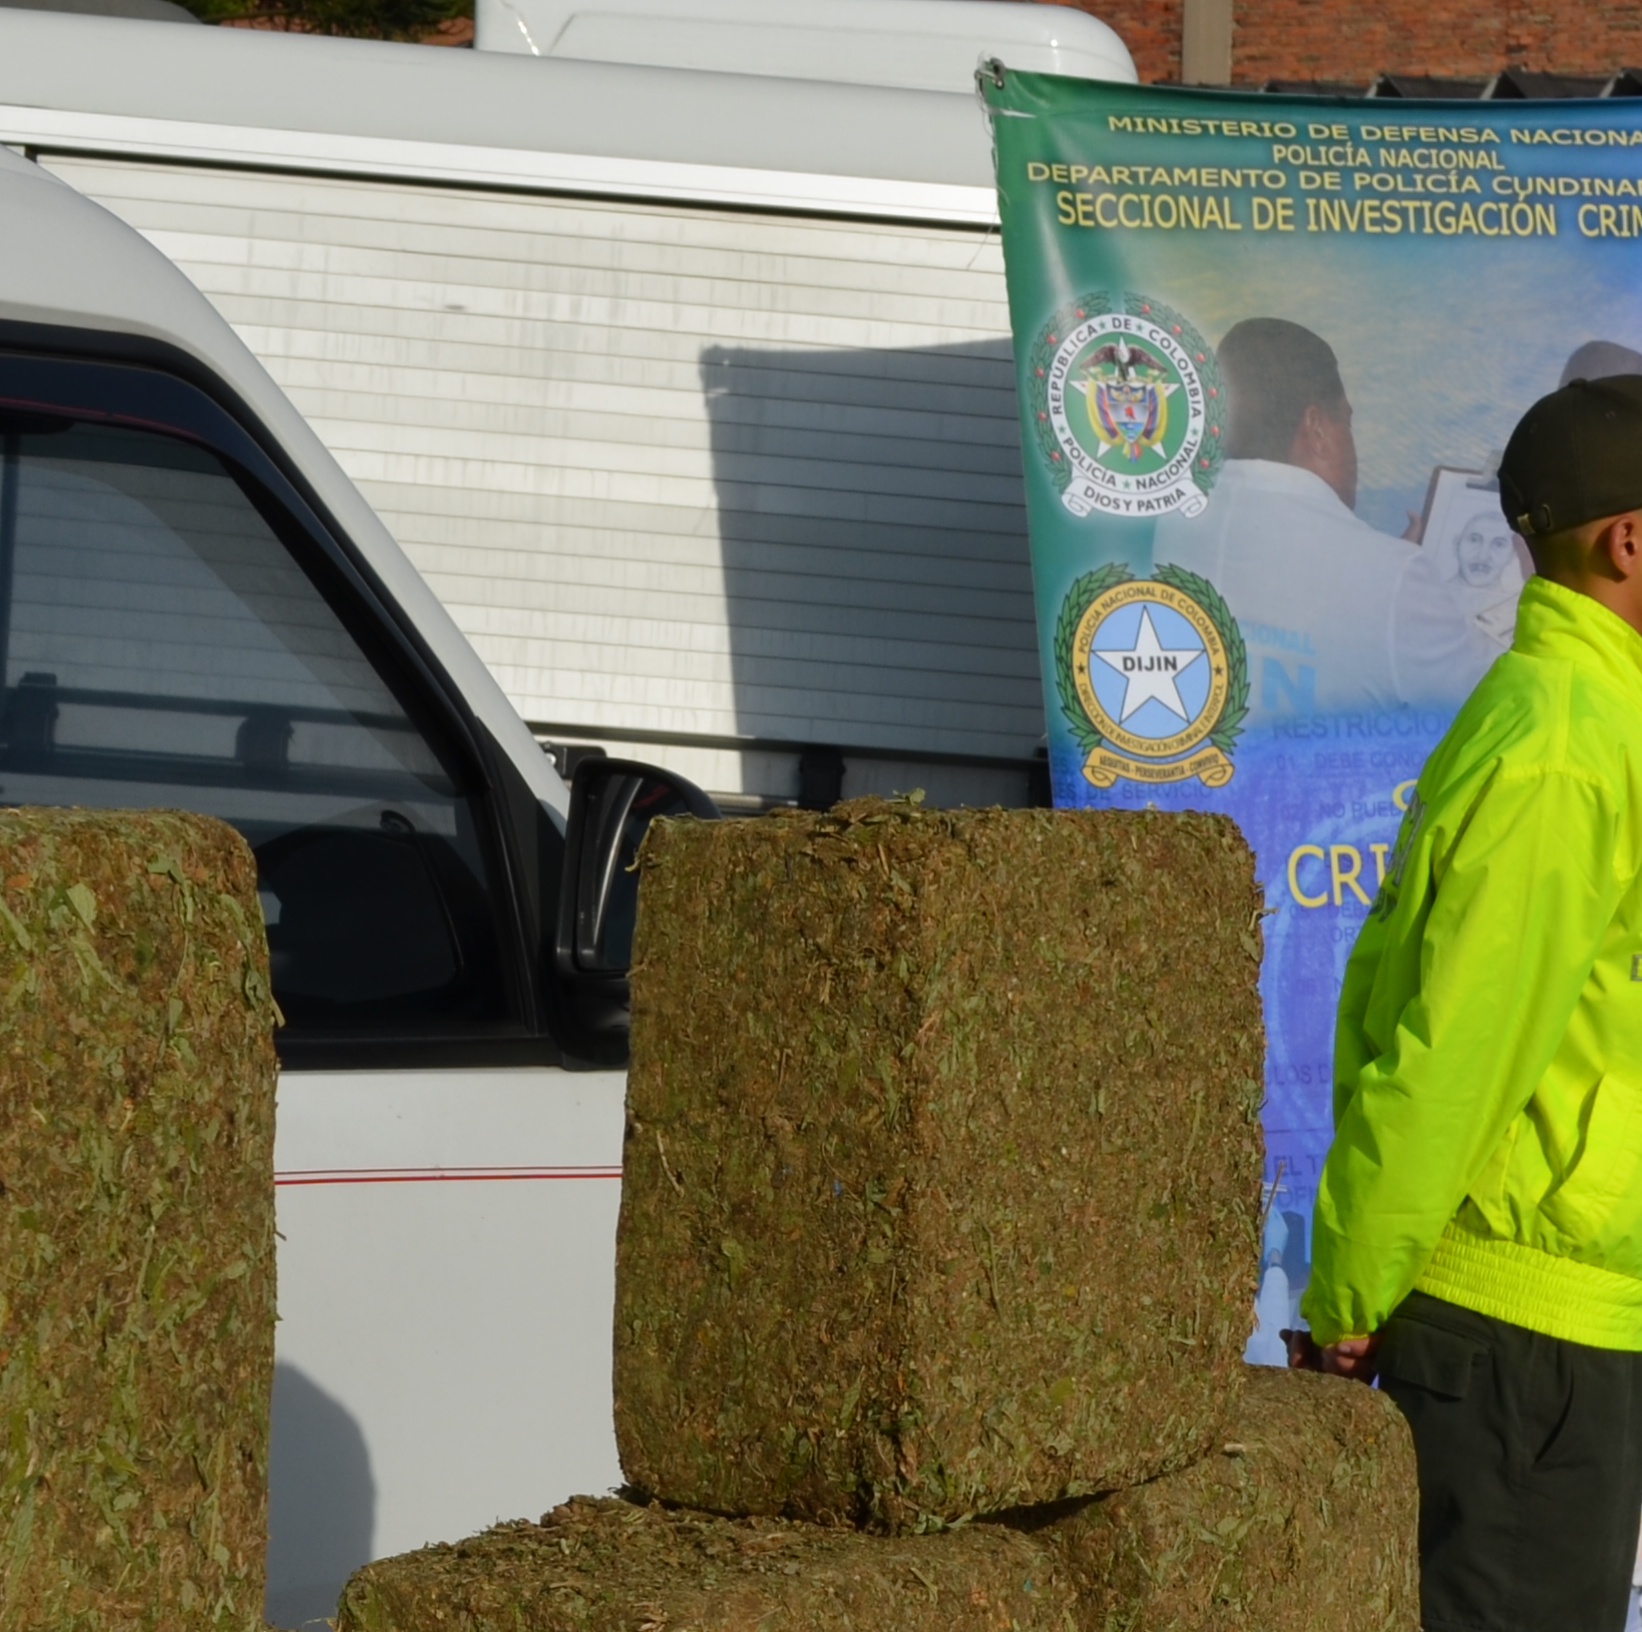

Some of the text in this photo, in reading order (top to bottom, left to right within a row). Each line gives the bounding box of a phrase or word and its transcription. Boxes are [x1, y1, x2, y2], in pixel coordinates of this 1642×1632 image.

[1108, 115, 1297, 138] MINISTERIO
[1308, 122, 1349, 140] DE
[1360, 125, 1500, 143] DEFENSA
[1272, 141, 1505, 170] POLICÍA NACIONAL
[1027, 161, 1287, 189] DEPARTAMENTO
[1299, 171, 1342, 190] DE
[1354, 169, 1482, 194] POLICÍA
[1057, 190, 1242, 230] SECCIONAL
[1252, 195, 1295, 231] DE
[1307, 190, 1557, 237] INVESTIGACIÓN
[1111, 316, 1132, 331] DE
[1148, 327, 1203, 419] COLOMBIA
[1135, 438, 1199, 491] NACIONAL
[1082, 484, 1187, 512] DIOS Y PATRIA
[1101, 586, 1157, 611] NACIONAL
[1160, 588, 1177, 603] DE
[1177, 598, 1221, 656] COLOMBIA
[1122, 655, 1178, 672] DIJIN
[1122, 782, 1213, 800] SERVICIO
